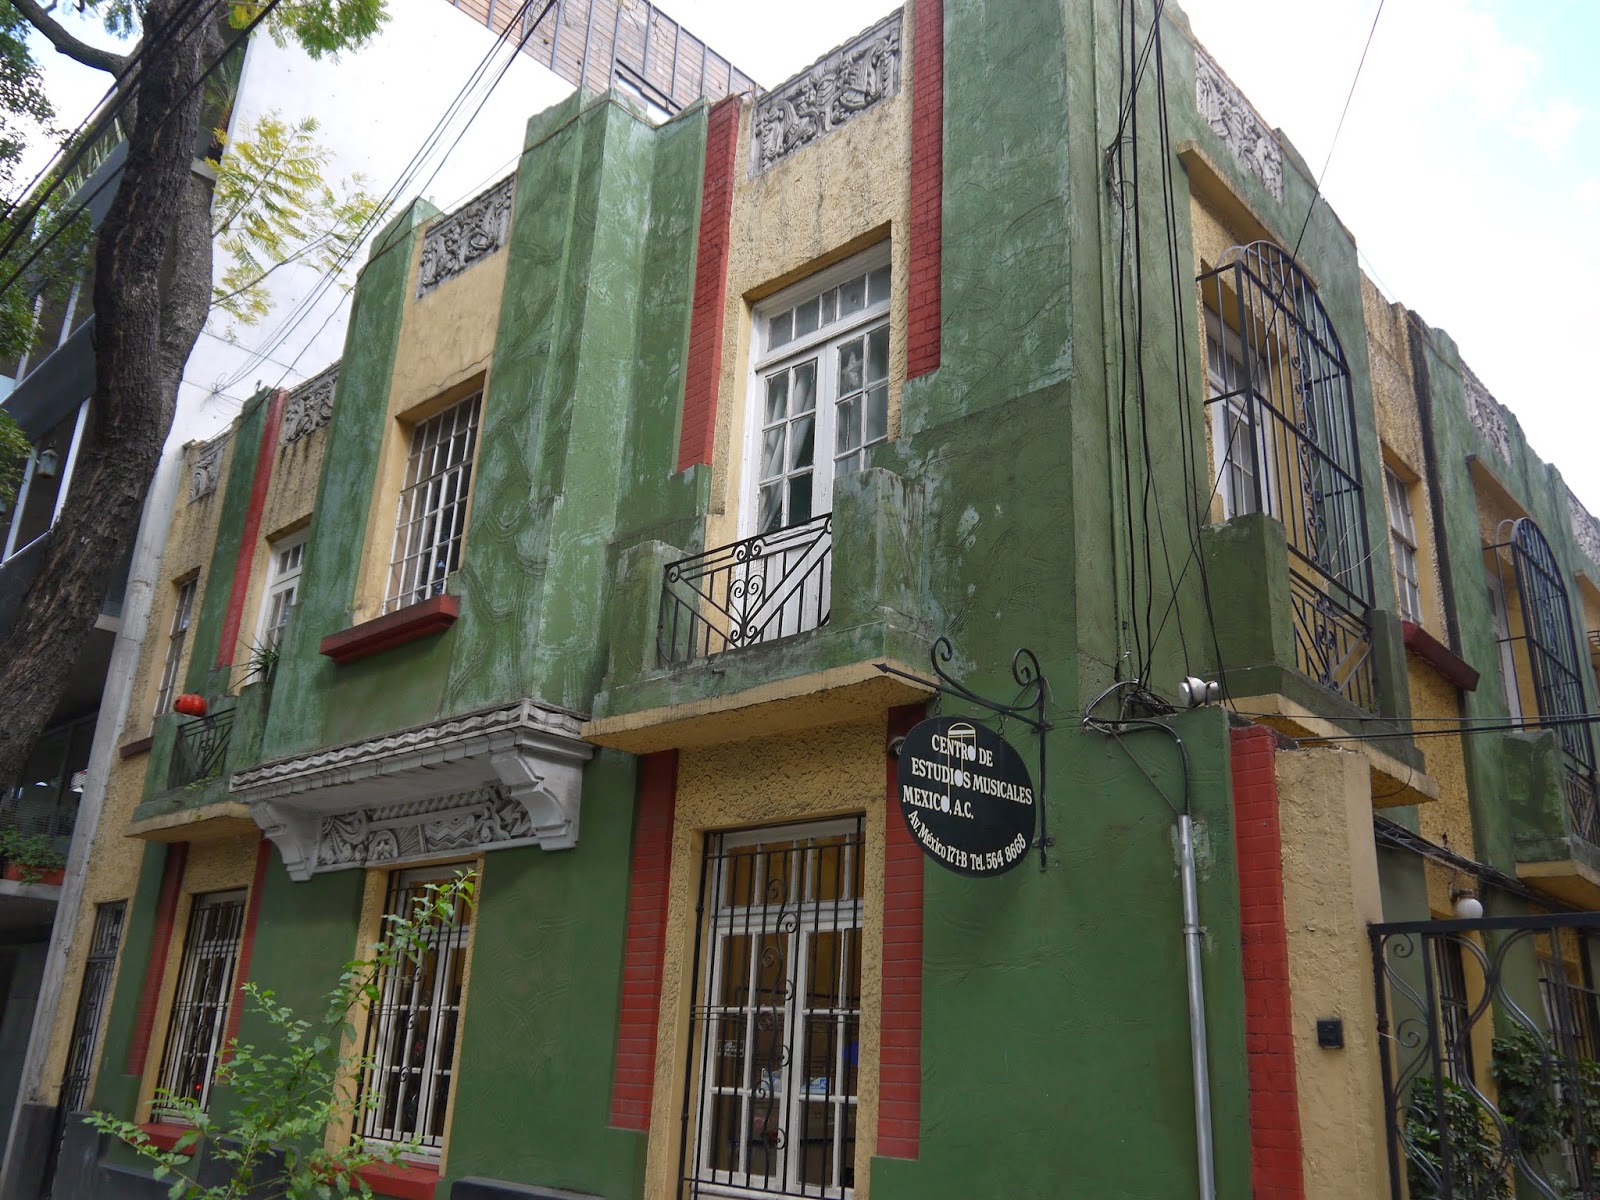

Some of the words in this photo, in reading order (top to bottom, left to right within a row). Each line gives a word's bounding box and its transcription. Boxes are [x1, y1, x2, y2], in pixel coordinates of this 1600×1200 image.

[931, 734, 976, 762] CENTRO
[978, 747, 994, 768] DE
[911, 757, 971, 789] ESTUDIOS
[972, 774, 1033, 806] MUSICALES
[953, 799, 975, 820] A.C.
[908, 810, 921, 833] Av.
[917, 823, 947, 859] México
[946, 845, 968, 869] 171-B
[970, 853, 986, 871] Tel.
[986, 849, 1004, 870] 564
[1004, 832, 1027, 863] 8668
